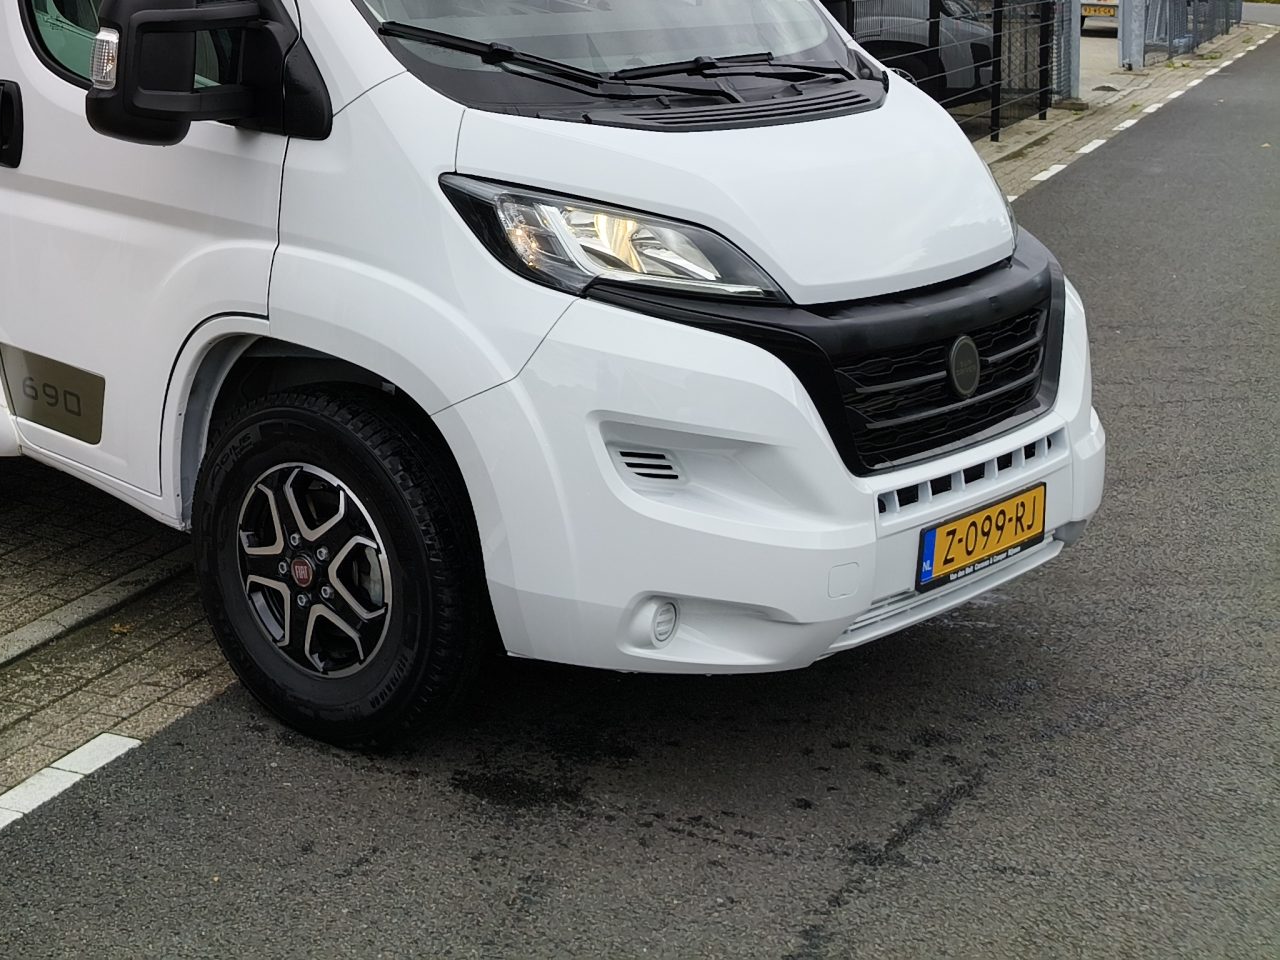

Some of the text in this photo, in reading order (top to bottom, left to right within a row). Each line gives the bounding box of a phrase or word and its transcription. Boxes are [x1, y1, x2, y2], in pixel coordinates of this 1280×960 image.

[22, 377, 82, 417] 690
[942, 495, 1037, 566] Z-099-RJ
[922, 559, 933, 572] NL
